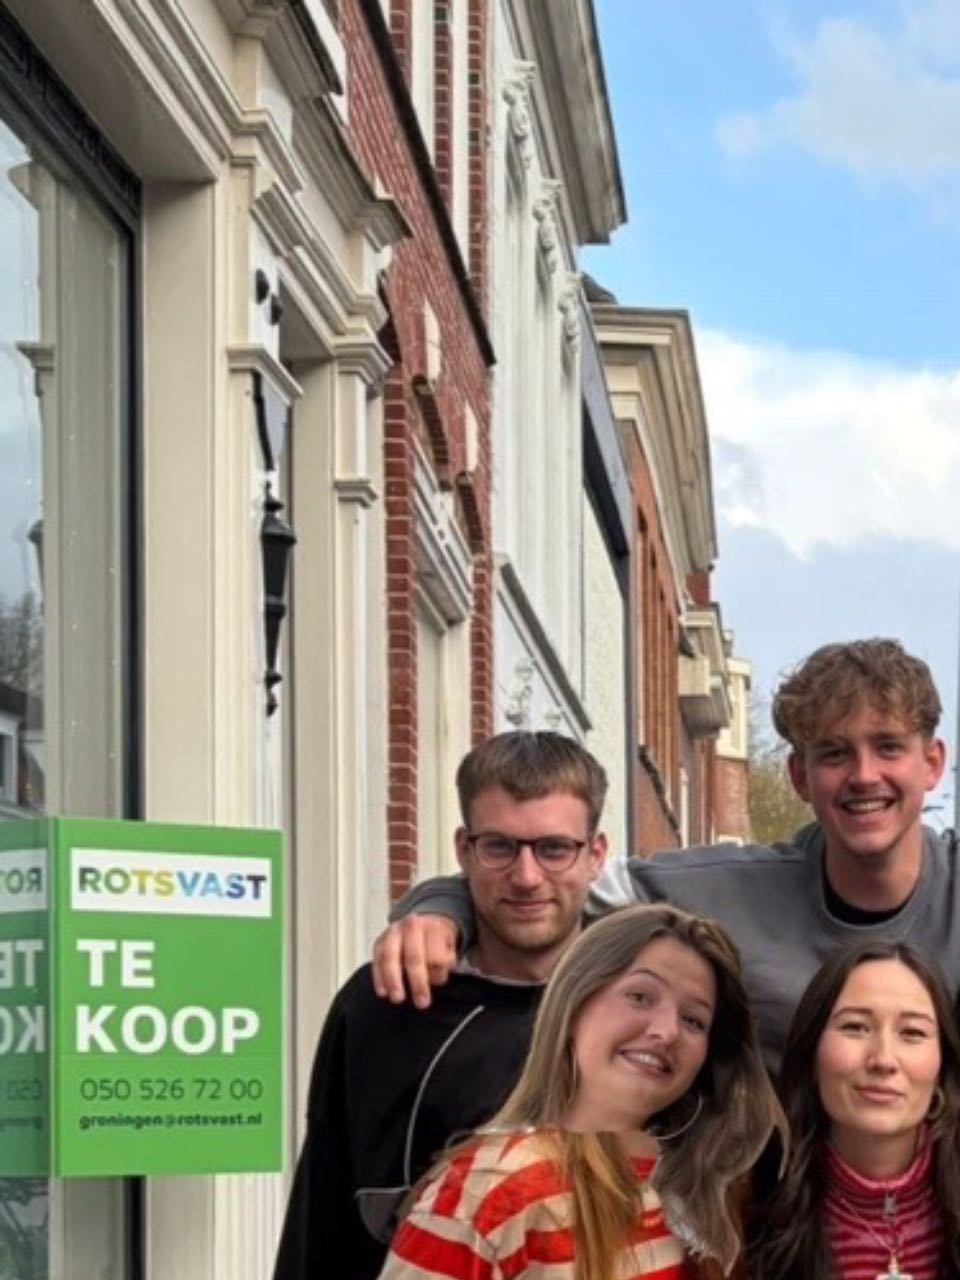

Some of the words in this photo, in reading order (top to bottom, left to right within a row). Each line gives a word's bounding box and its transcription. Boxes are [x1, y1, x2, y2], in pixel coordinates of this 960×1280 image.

[78, 866, 267, 900] ROTSVAST
[76, 938, 155, 989] TE
[75, 1004, 260, 1056] KOOP
[79, 1078, 132, 1101] 050
[139, 1078, 185, 1101] 526
[193, 1079, 222, 1101] 72
[229, 1078, 263, 1101] 00
[79, 1112, 263, 1130] groningen@rotsvast.nl
